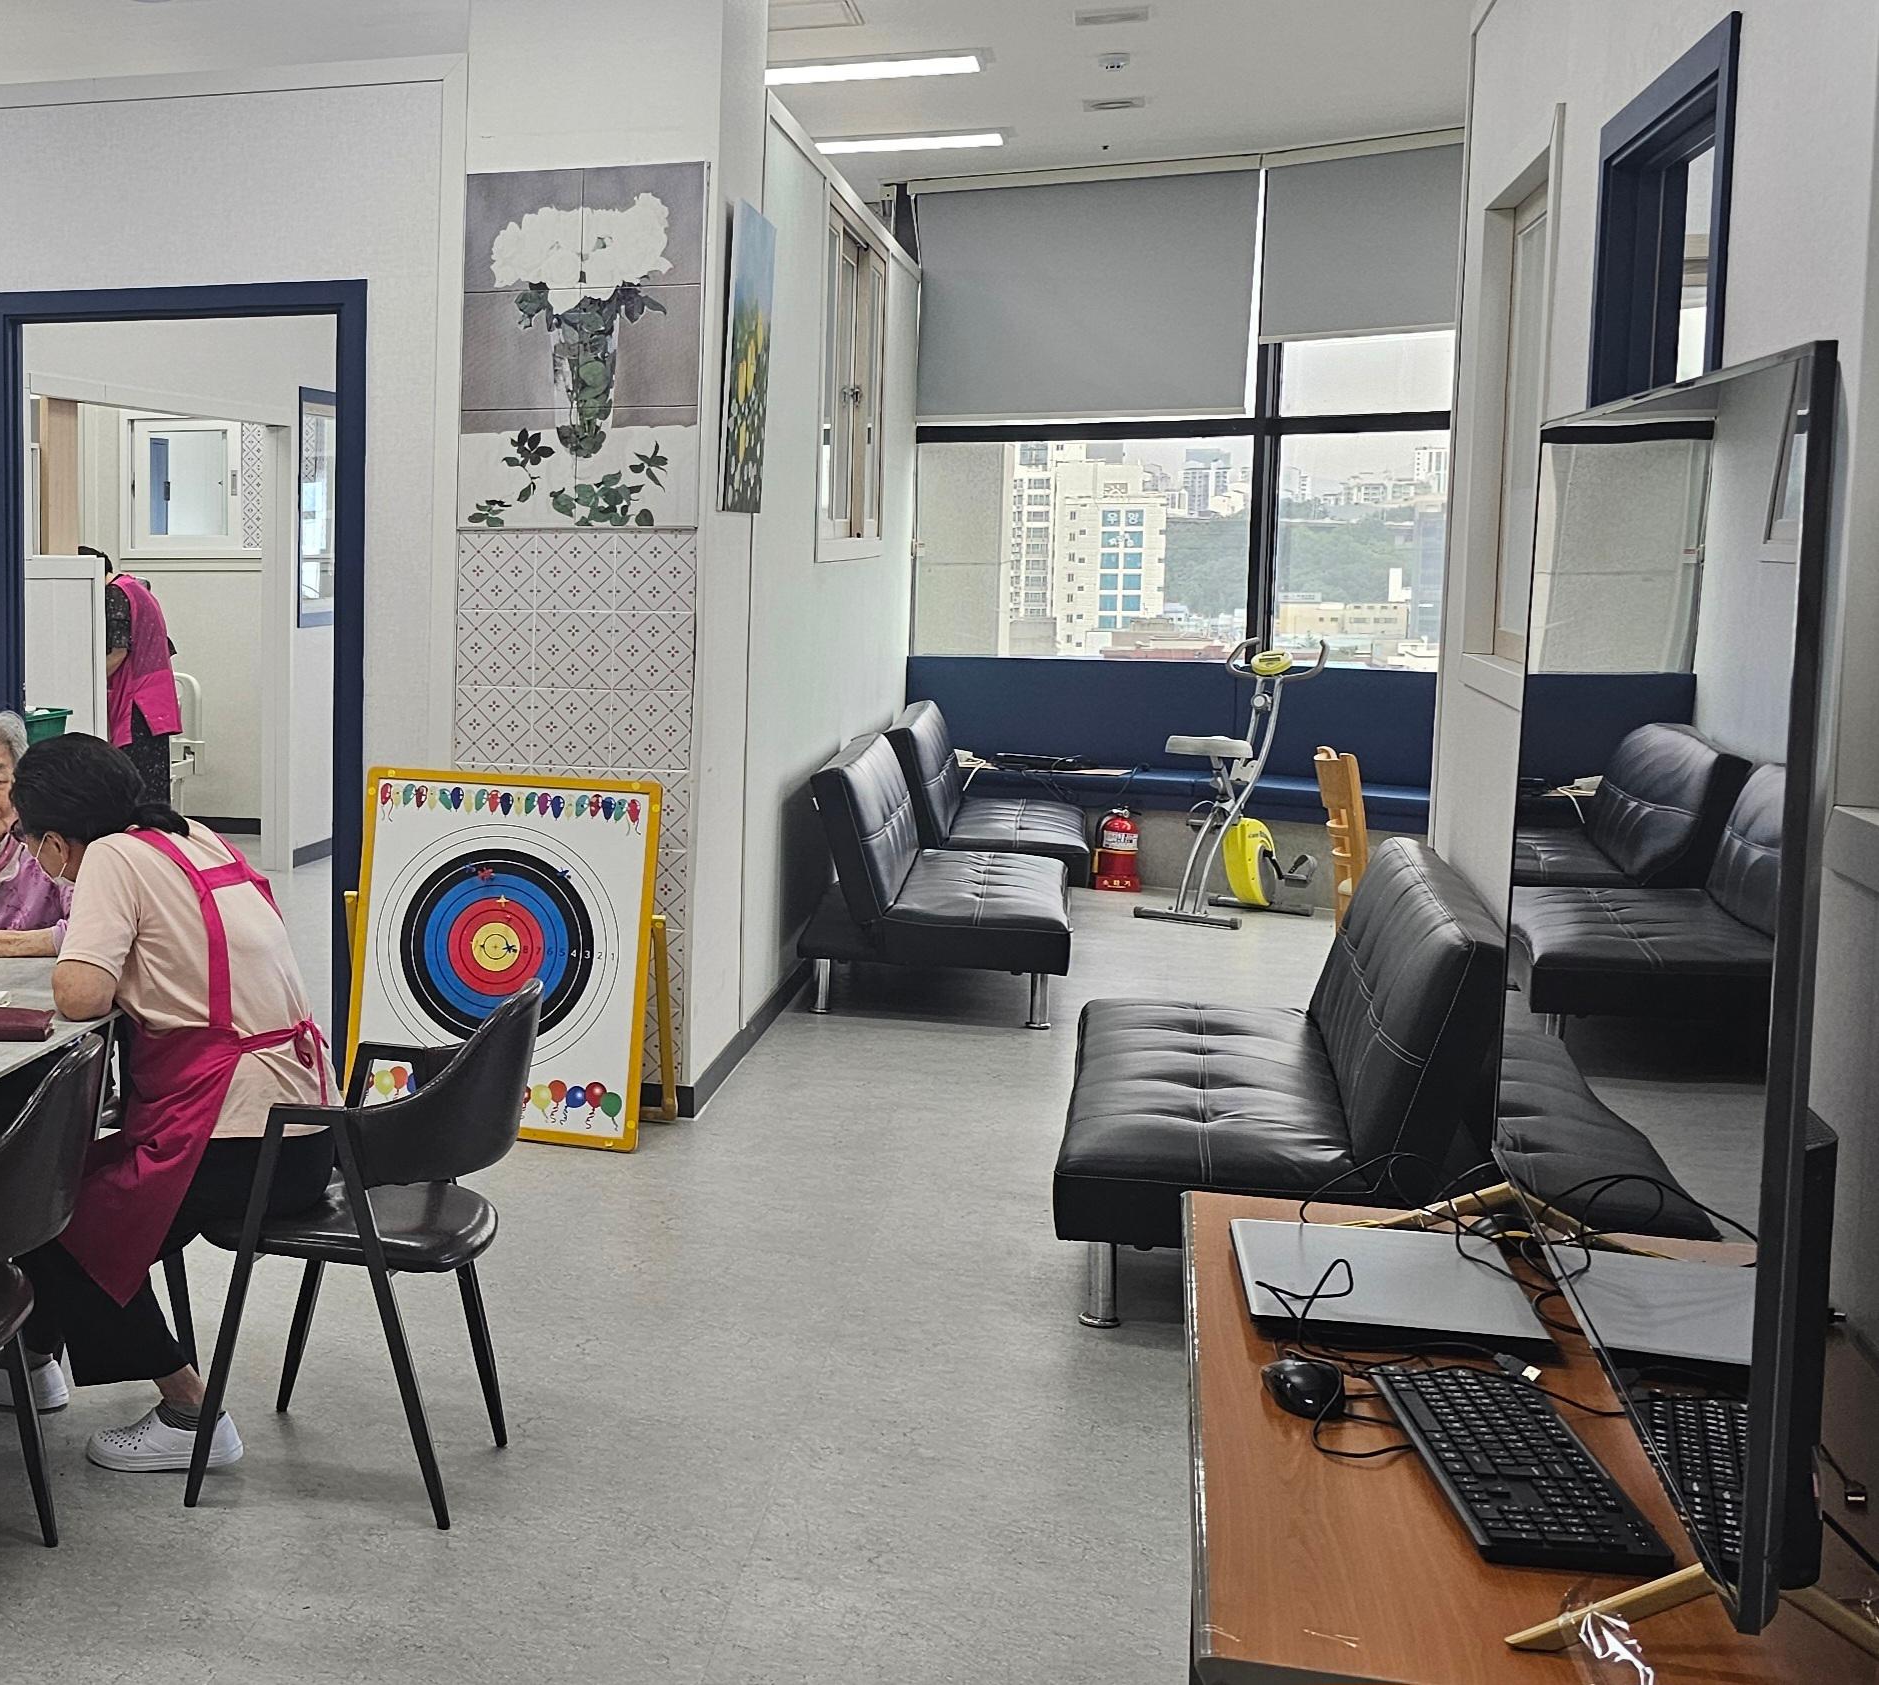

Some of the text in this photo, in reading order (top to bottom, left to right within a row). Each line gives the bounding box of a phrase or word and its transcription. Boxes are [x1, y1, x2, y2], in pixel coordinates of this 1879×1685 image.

[523, 945, 529, 954] 8
[536, 947, 542, 956] 7
[547, 947, 554, 956] 6
[558, 948, 566, 957] 5
[570, 949, 577, 958] 4
[584, 950, 591, 959] 3
[597, 951, 603, 960] 2
[611, 953, 615, 961] 1
